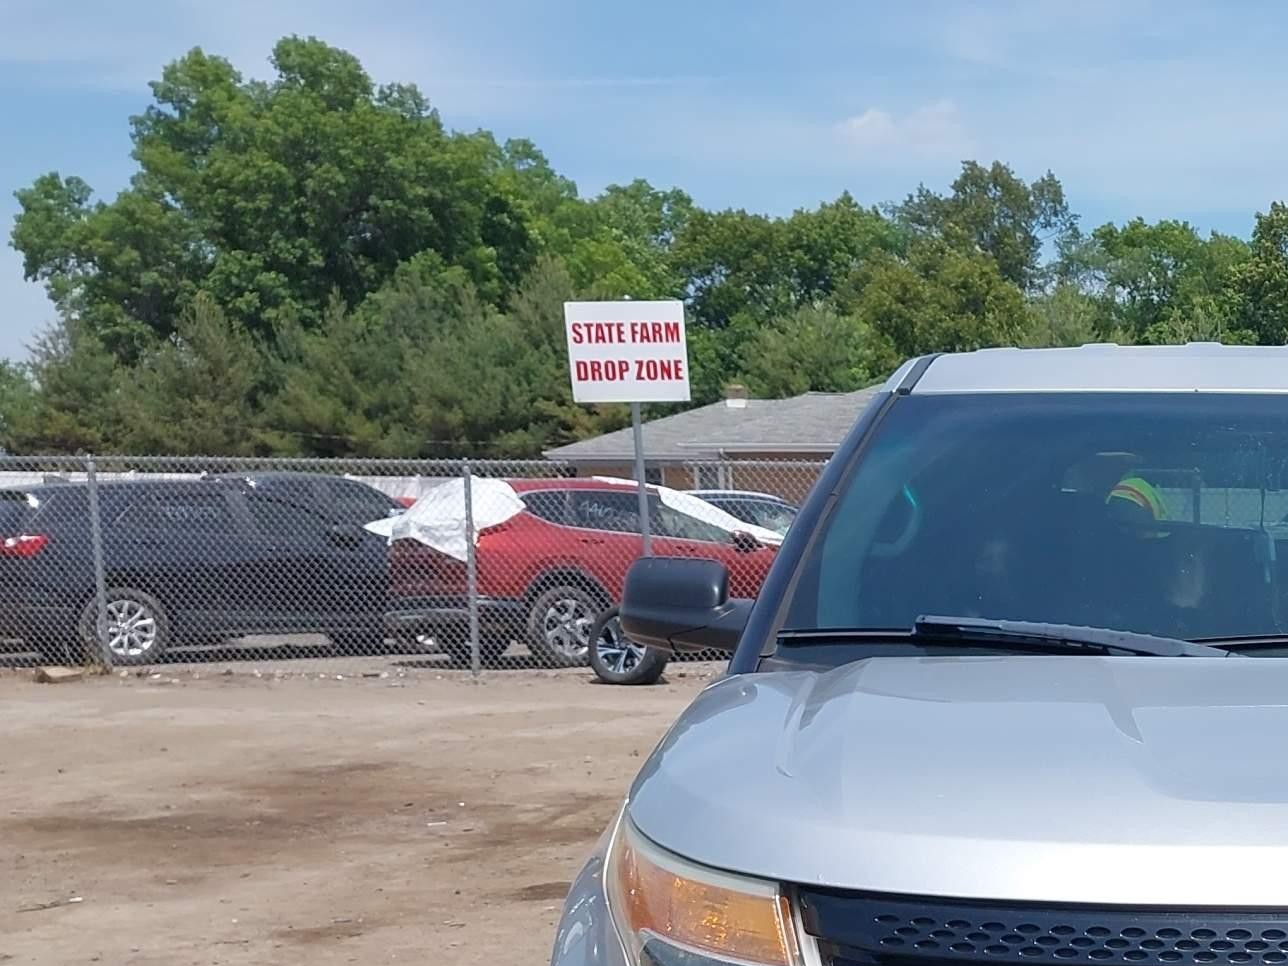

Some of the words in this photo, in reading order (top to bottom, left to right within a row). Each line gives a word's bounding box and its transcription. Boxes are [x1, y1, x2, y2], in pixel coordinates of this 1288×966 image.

[571, 322, 626, 344] STATE
[630, 321, 681, 343] FARM
[575, 361, 630, 381] DROP
[634, 359, 684, 380] ZONE
